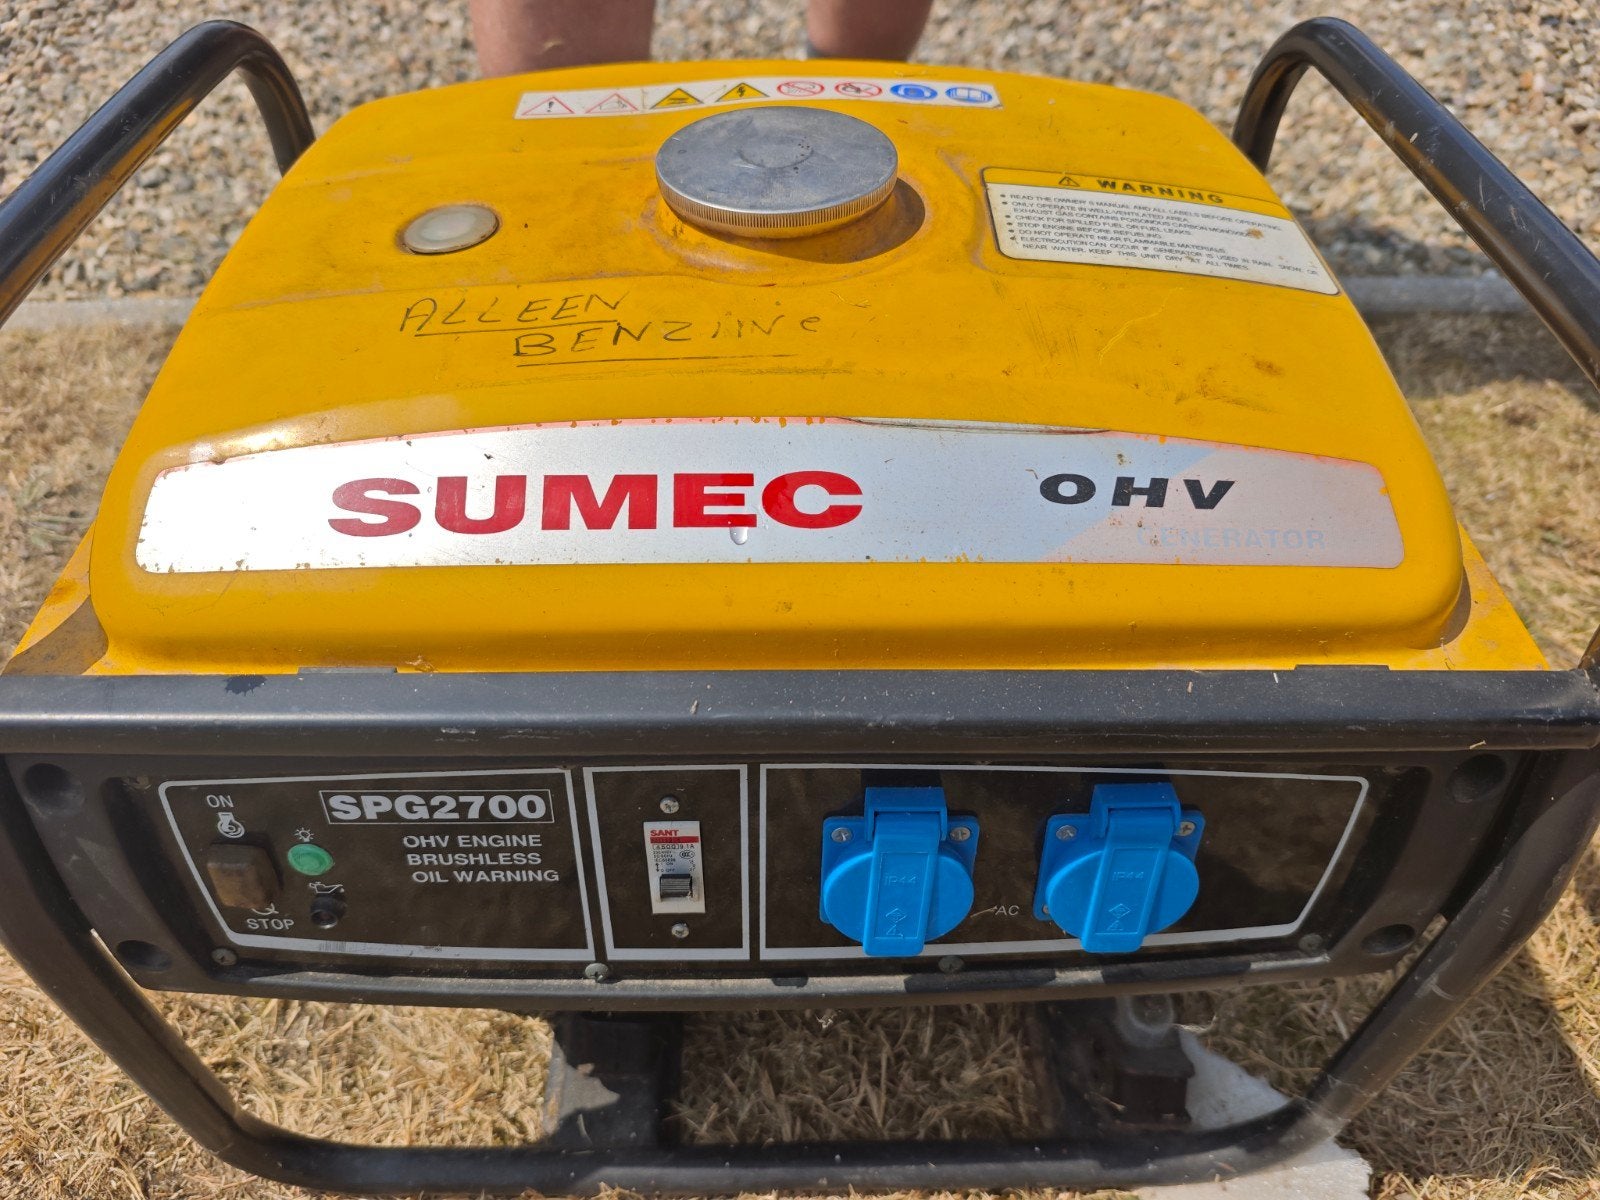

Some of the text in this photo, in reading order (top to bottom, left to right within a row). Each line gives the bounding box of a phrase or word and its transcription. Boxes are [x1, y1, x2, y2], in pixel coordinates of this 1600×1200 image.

[1097, 180, 1223, 203] WARNING
[1036, 203, 1076, 212] OPERATE
[1096, 201, 1130, 209] MANUAL
[1168, 209, 1200, 217] LABELS
[1201, 213, 1233, 222] BEFORE
[1075, 212, 1119, 220] CONTAINS
[1121, 216, 1171, 226] POISONOUS
[1172, 222, 1208, 231] CARBON
[1076, 226, 1111, 234] BEFORE
[1054, 231, 1095, 239] OPERATE
[1123, 237, 1176, 247] FLAMMABLE
[1020, 236, 1088, 246] ELECTROCUTION
[1109, 243, 1140, 251] OCCUR
[1153, 247, 1203, 257] GENERATOR
[1217, 255, 1239, 263] USED
[399, 290, 629, 332] ALLEEN
[1039, 473, 1236, 510] OHV
[328, 470, 863, 537] SUMEC
[1136, 526, 1326, 550] GENERATOR
[206, 794, 234, 809] ON
[328, 794, 547, 821] SPG2700
[650, 829, 679, 837] SANT
[403, 834, 543, 849] OHV ENGINE
[406, 852, 542, 866] BRUSHLESS
[412, 869, 560, 883] OIL WARNING
[1112, 871, 1145, 881] IP44
[995, 905, 1020, 916] AC
[246, 918, 295, 931] STOP
